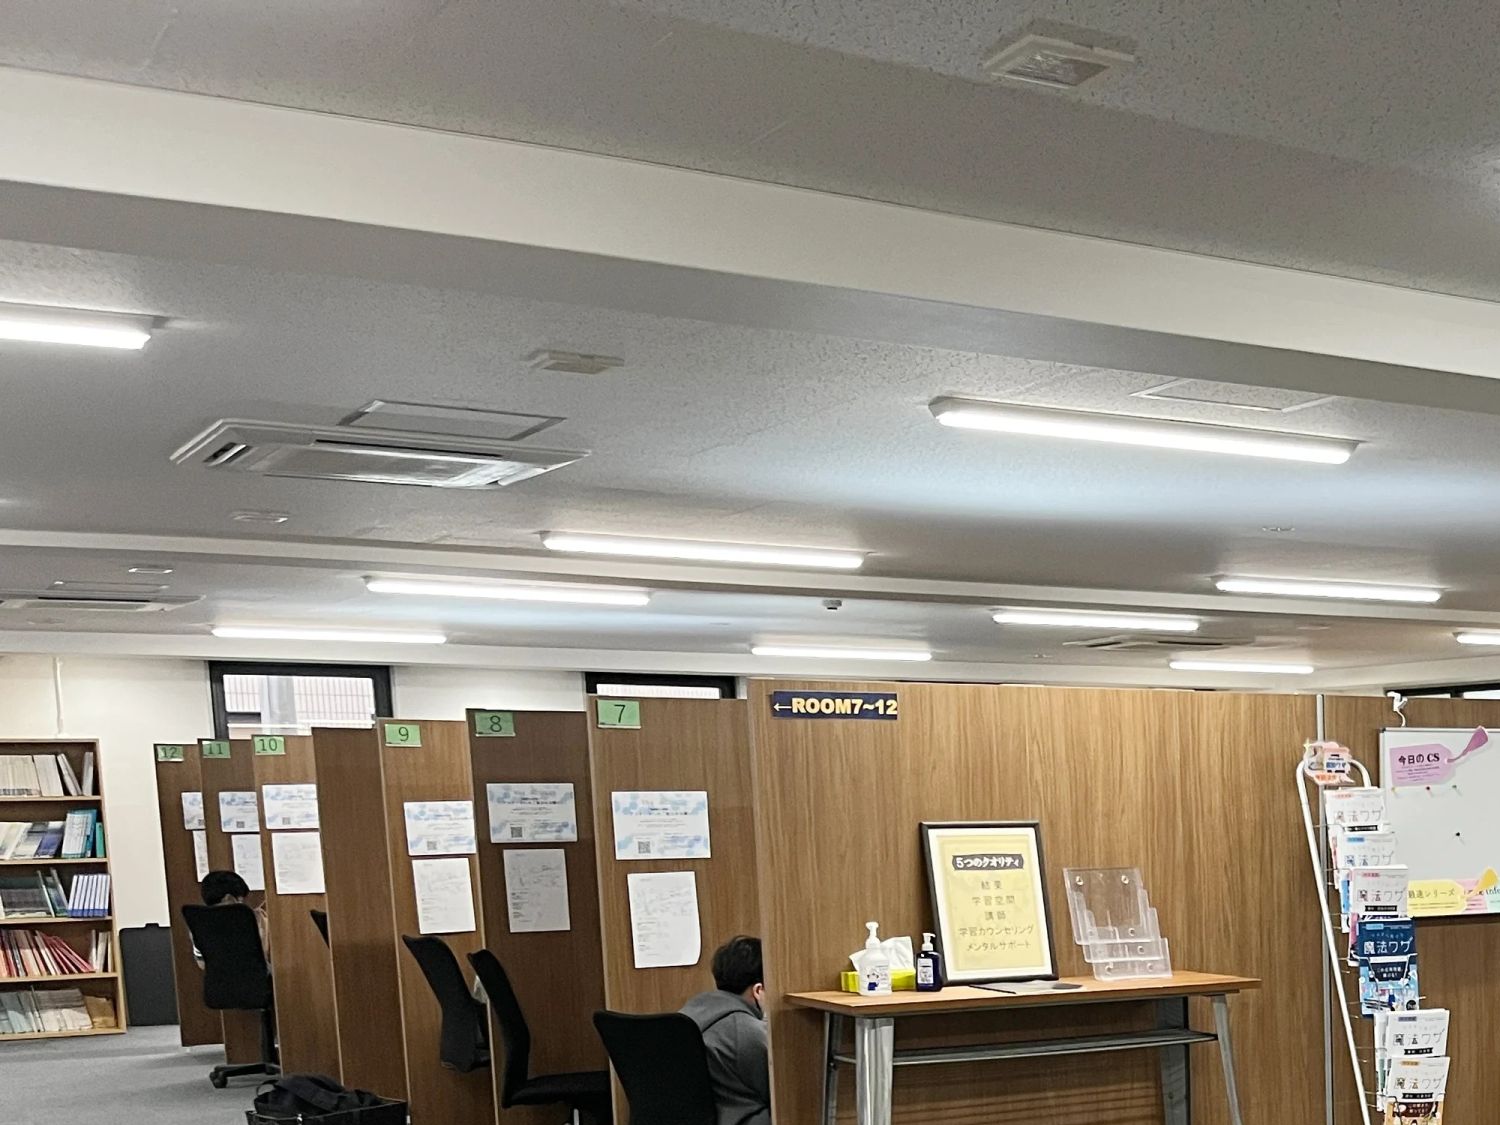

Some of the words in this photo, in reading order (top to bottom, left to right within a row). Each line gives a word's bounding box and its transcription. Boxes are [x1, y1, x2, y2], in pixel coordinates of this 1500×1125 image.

[614, 703, 626, 723] 7
[489, 715, 503, 733] 8
[398, 726, 409, 742] 9
[206, 742, 223, 755] 11
[259, 738, 277, 752] 10
[161, 747, 178, 759] 12
[1398, 754, 1424, 766] 今日の
[1427, 753, 1440, 762] CS
[956, 856, 1019, 868] 5つのクオリティ
[958, 924, 1034, 937] 学習カウンセリング
[967, 940, 1031, 951] メンタルサポート
[1363, 936, 1413, 955] 魔法ワザ
